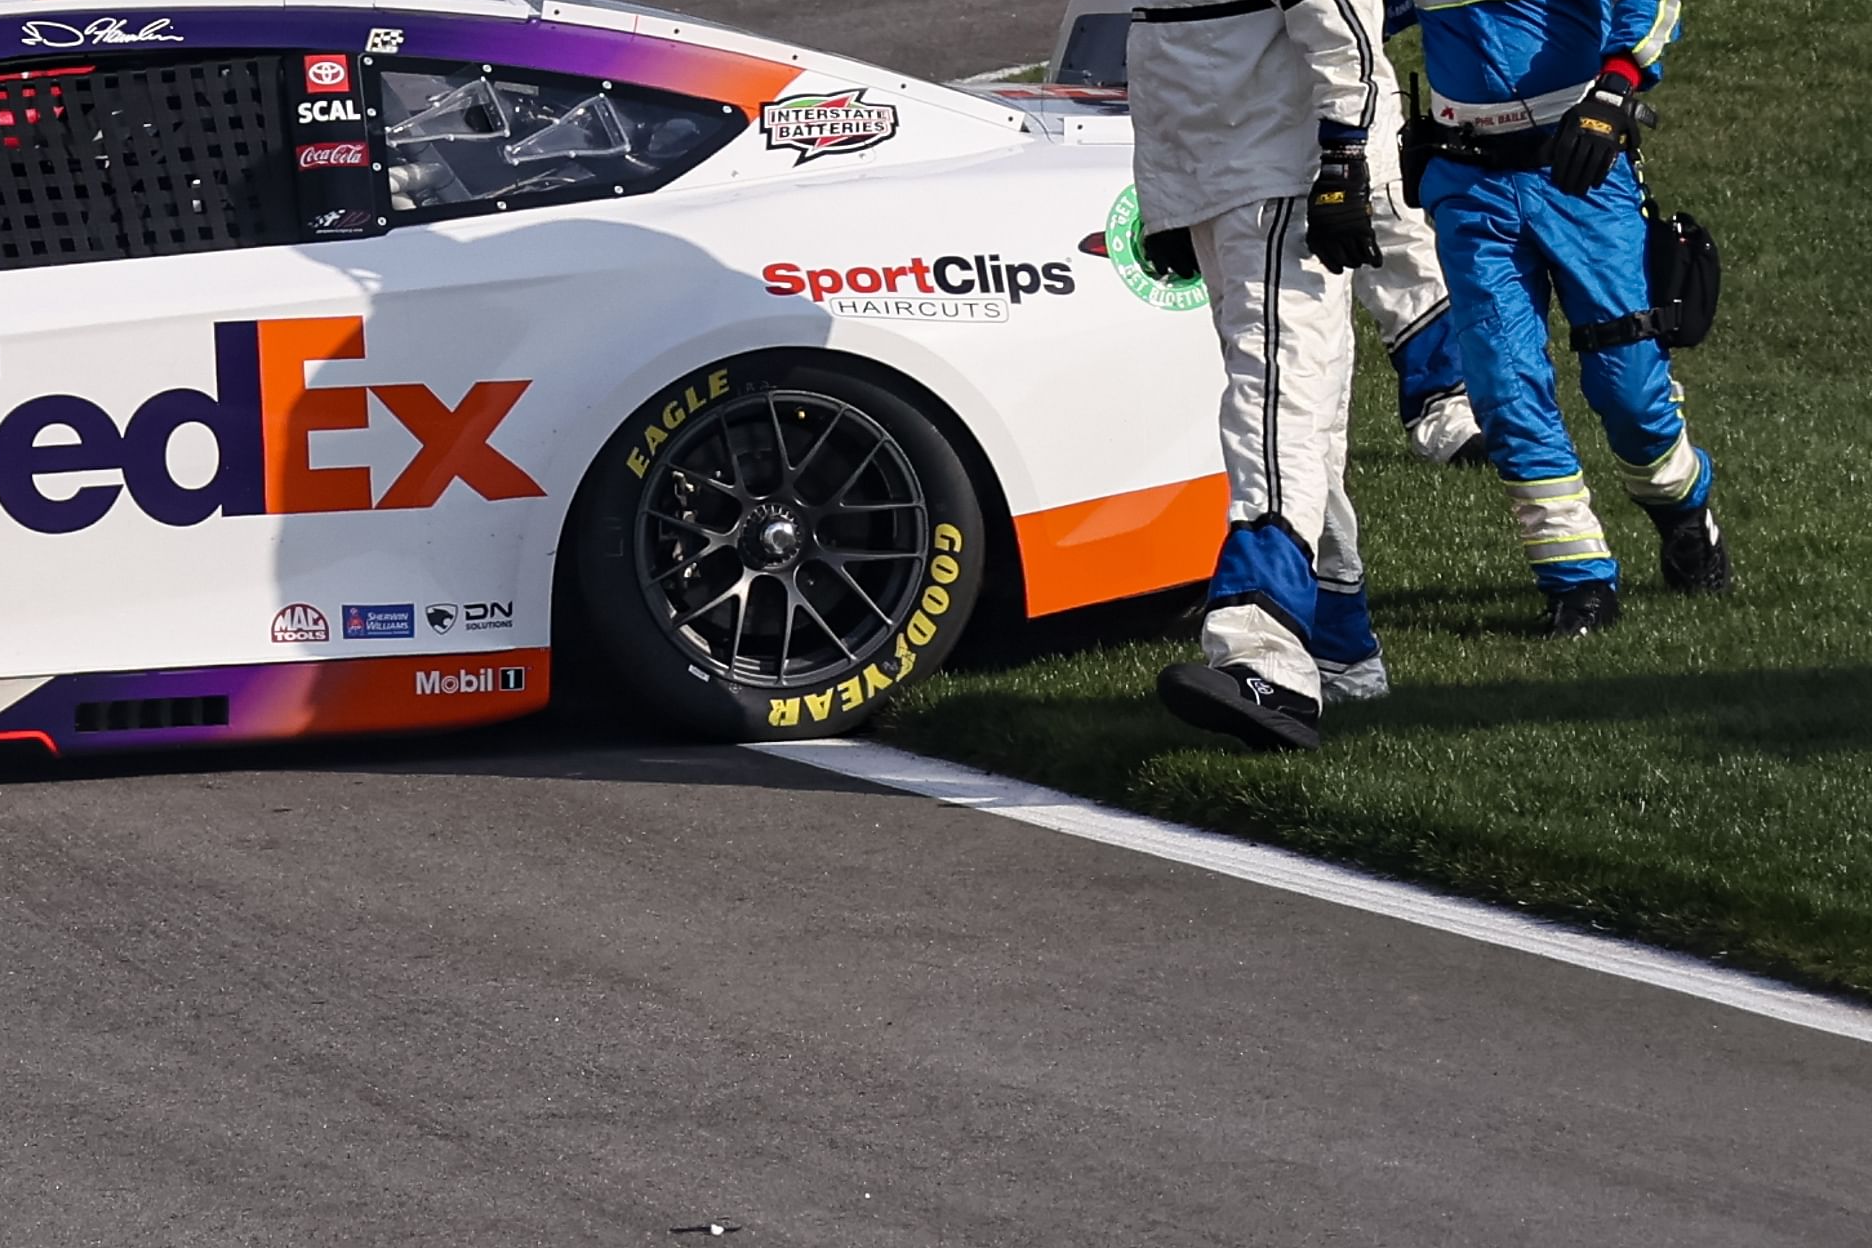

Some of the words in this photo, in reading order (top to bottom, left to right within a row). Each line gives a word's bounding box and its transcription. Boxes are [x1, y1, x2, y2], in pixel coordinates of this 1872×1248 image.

[297, 99, 362, 124] SCAL
[1475, 116, 1495, 128] PHIL
[1498, 109, 1534, 125] BAILEY
[778, 121, 886, 138] BATTERIES
[1114, 195, 1135, 226] GET
[761, 253, 1076, 305] SportClips
[837, 299, 1002, 320] HAIRCUTS
[626, 368, 731, 479] EAGLE
[274, 605, 327, 631] MAC
[367, 611, 409, 621] SHERWIN
[463, 600, 513, 621] DN
[365, 621, 409, 631] WILLIAMS
[465, 620, 513, 631] SOLUTIONS
[767, 522, 964, 728] GOODYEAR
[274, 631, 327, 641] TOOLS
[415, 667, 494, 696] Mobil
